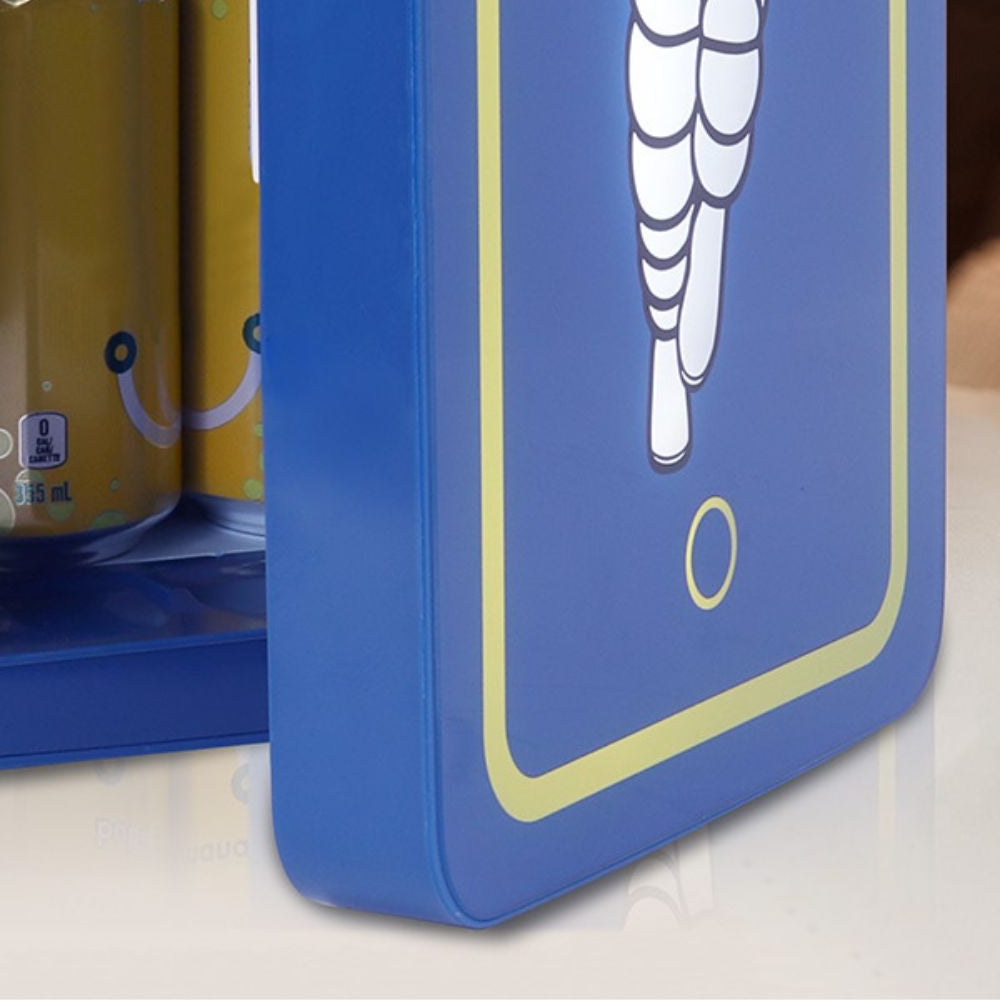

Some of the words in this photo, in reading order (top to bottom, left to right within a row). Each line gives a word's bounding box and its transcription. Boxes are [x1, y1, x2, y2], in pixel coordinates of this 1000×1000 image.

[39, 418, 49, 436] 0
[16, 483, 45, 504] 355
[51, 481, 72, 502] mL
